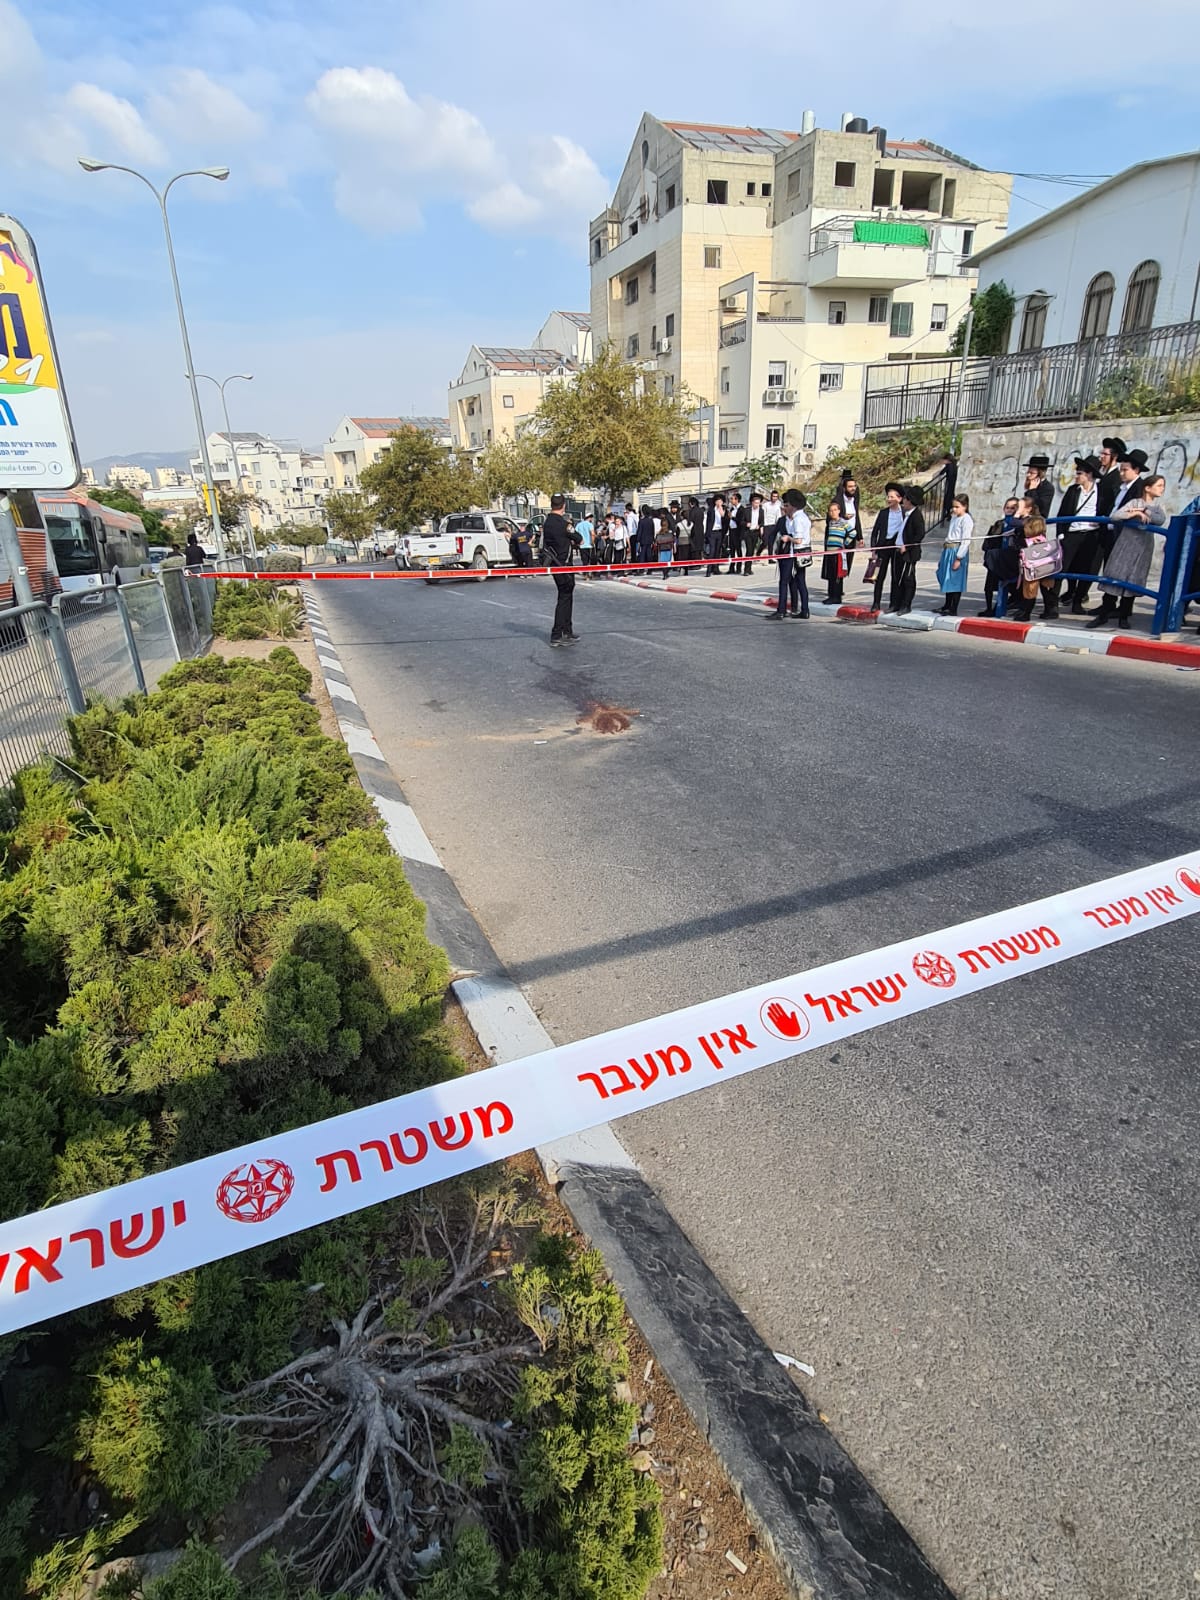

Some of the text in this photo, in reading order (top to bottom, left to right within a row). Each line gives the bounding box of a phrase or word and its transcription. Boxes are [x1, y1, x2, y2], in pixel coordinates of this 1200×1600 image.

[1083, 896, 1149, 929] מעבר
[1144, 885, 1184, 914] אין
[958, 926, 1060, 974] משטרת
[804, 973, 908, 1023] ישראל
[697, 1023, 757, 1070] אין
[576, 1045, 692, 1100] מעבר
[315, 1100, 514, 1193] משטרת
